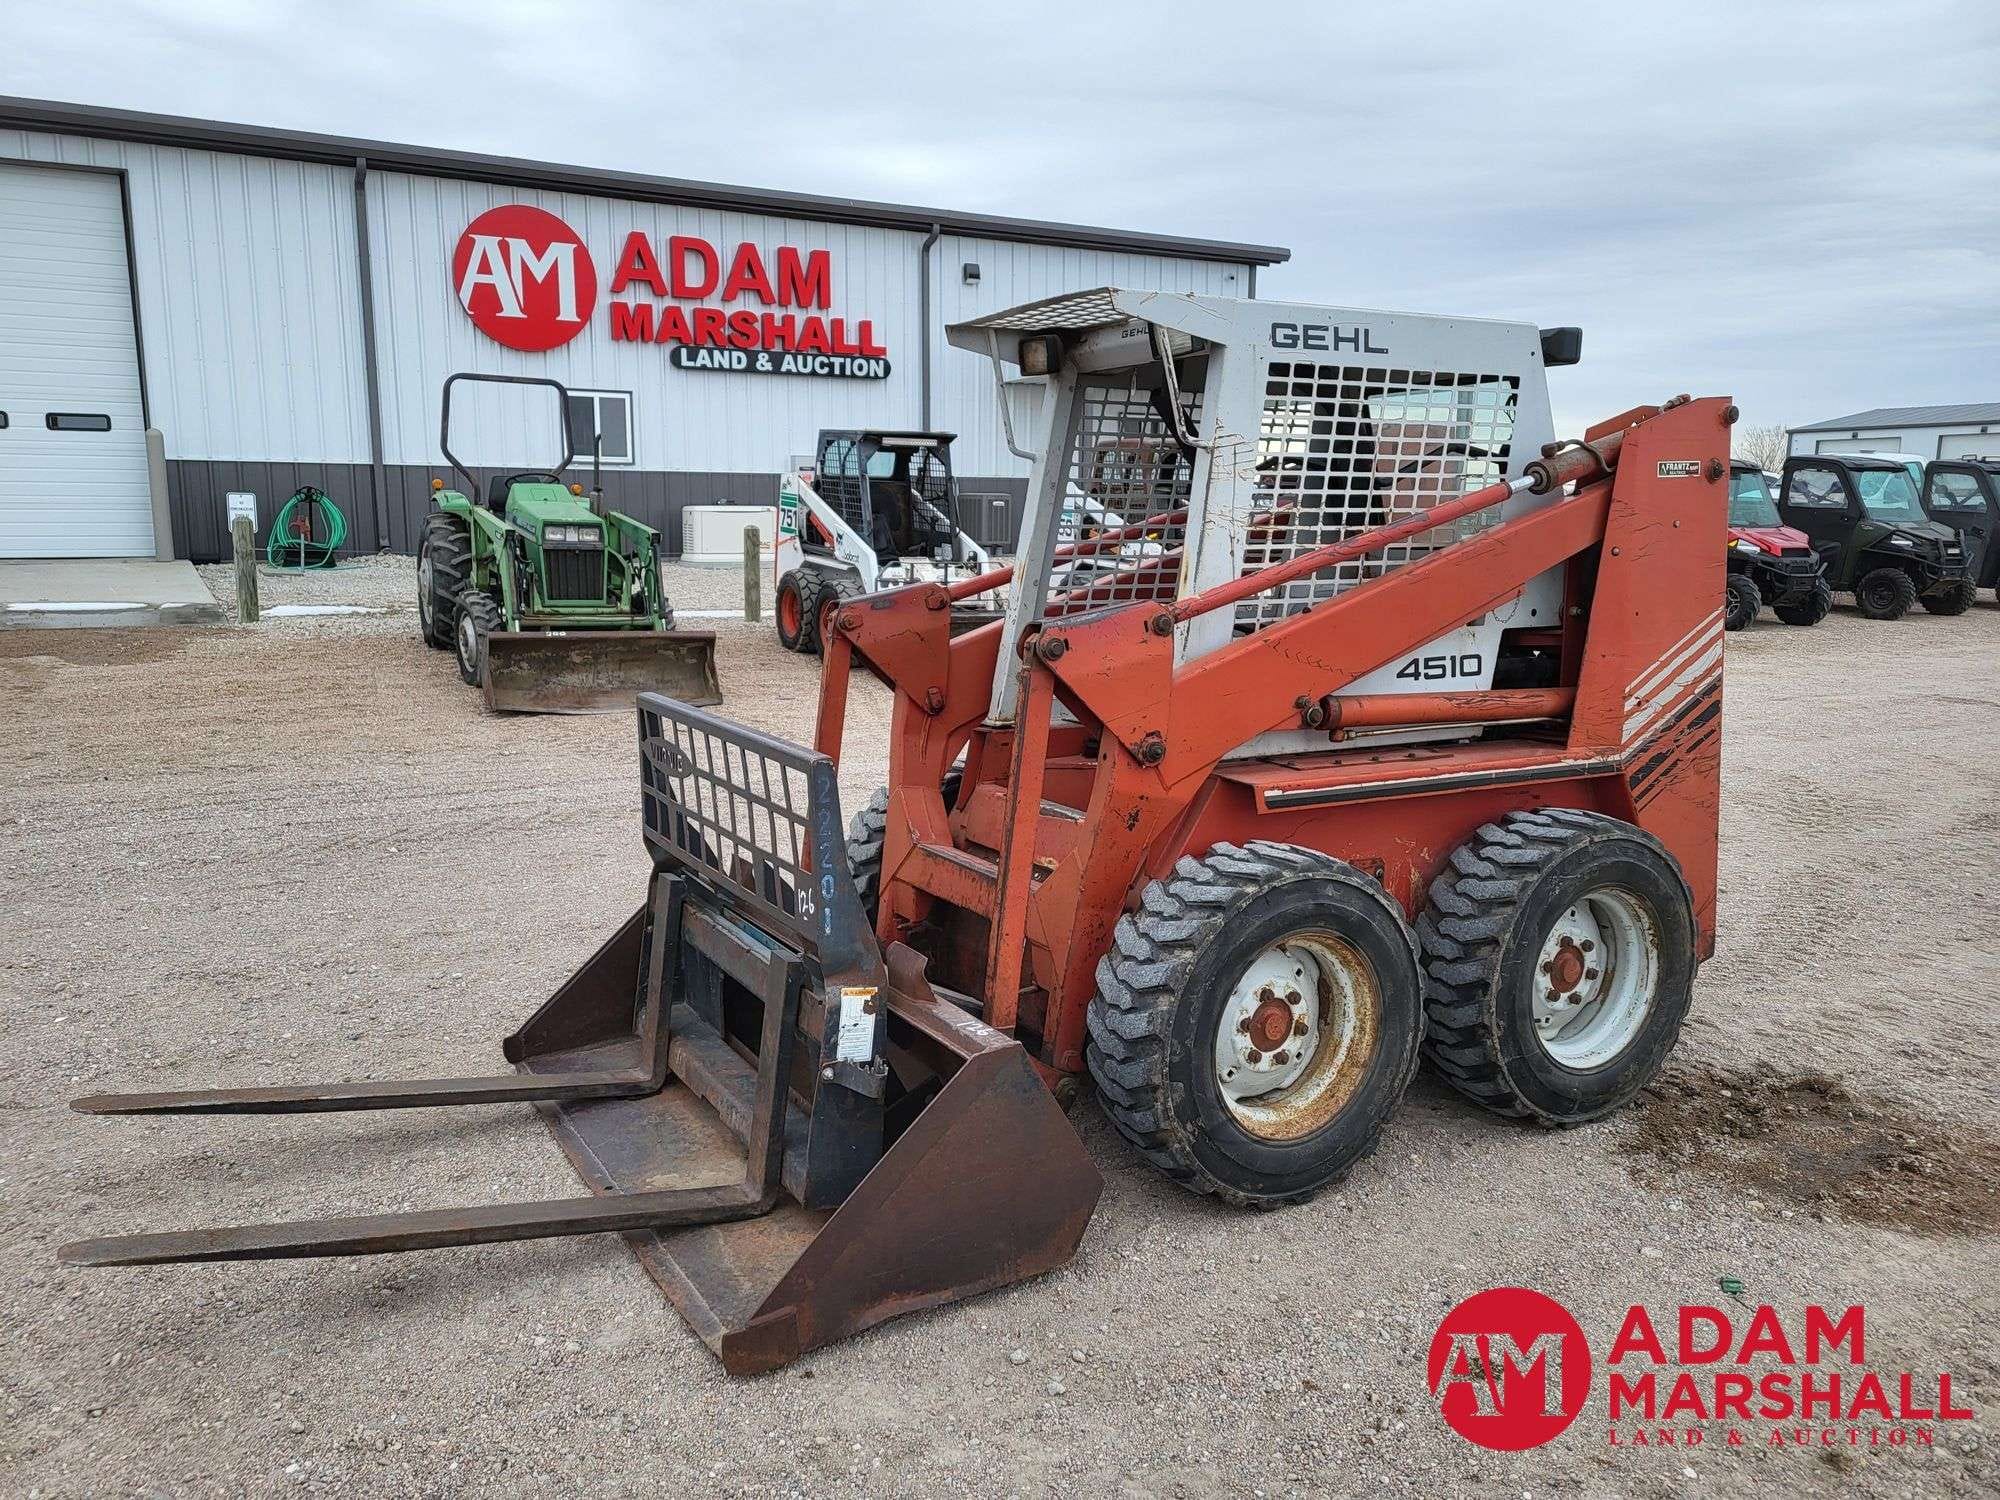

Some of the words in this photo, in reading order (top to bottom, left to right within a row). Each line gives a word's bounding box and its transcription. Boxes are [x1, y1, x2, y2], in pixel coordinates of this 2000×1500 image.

[459, 234, 581, 322] AM
[610, 231, 832, 310] ADAM
[610, 301, 888, 358] MARSHALL
[1121, 327, 1150, 339] GEHL
[1271, 322, 1389, 355] GEHL
[680, 348, 748, 369] LAND
[755, 354, 774, 372] &
[780, 355, 885, 378] AUCTION
[1666, 463, 1690, 471] FRANTZ
[780, 507, 798, 529] 751
[1396, 653, 1482, 681] 4510
